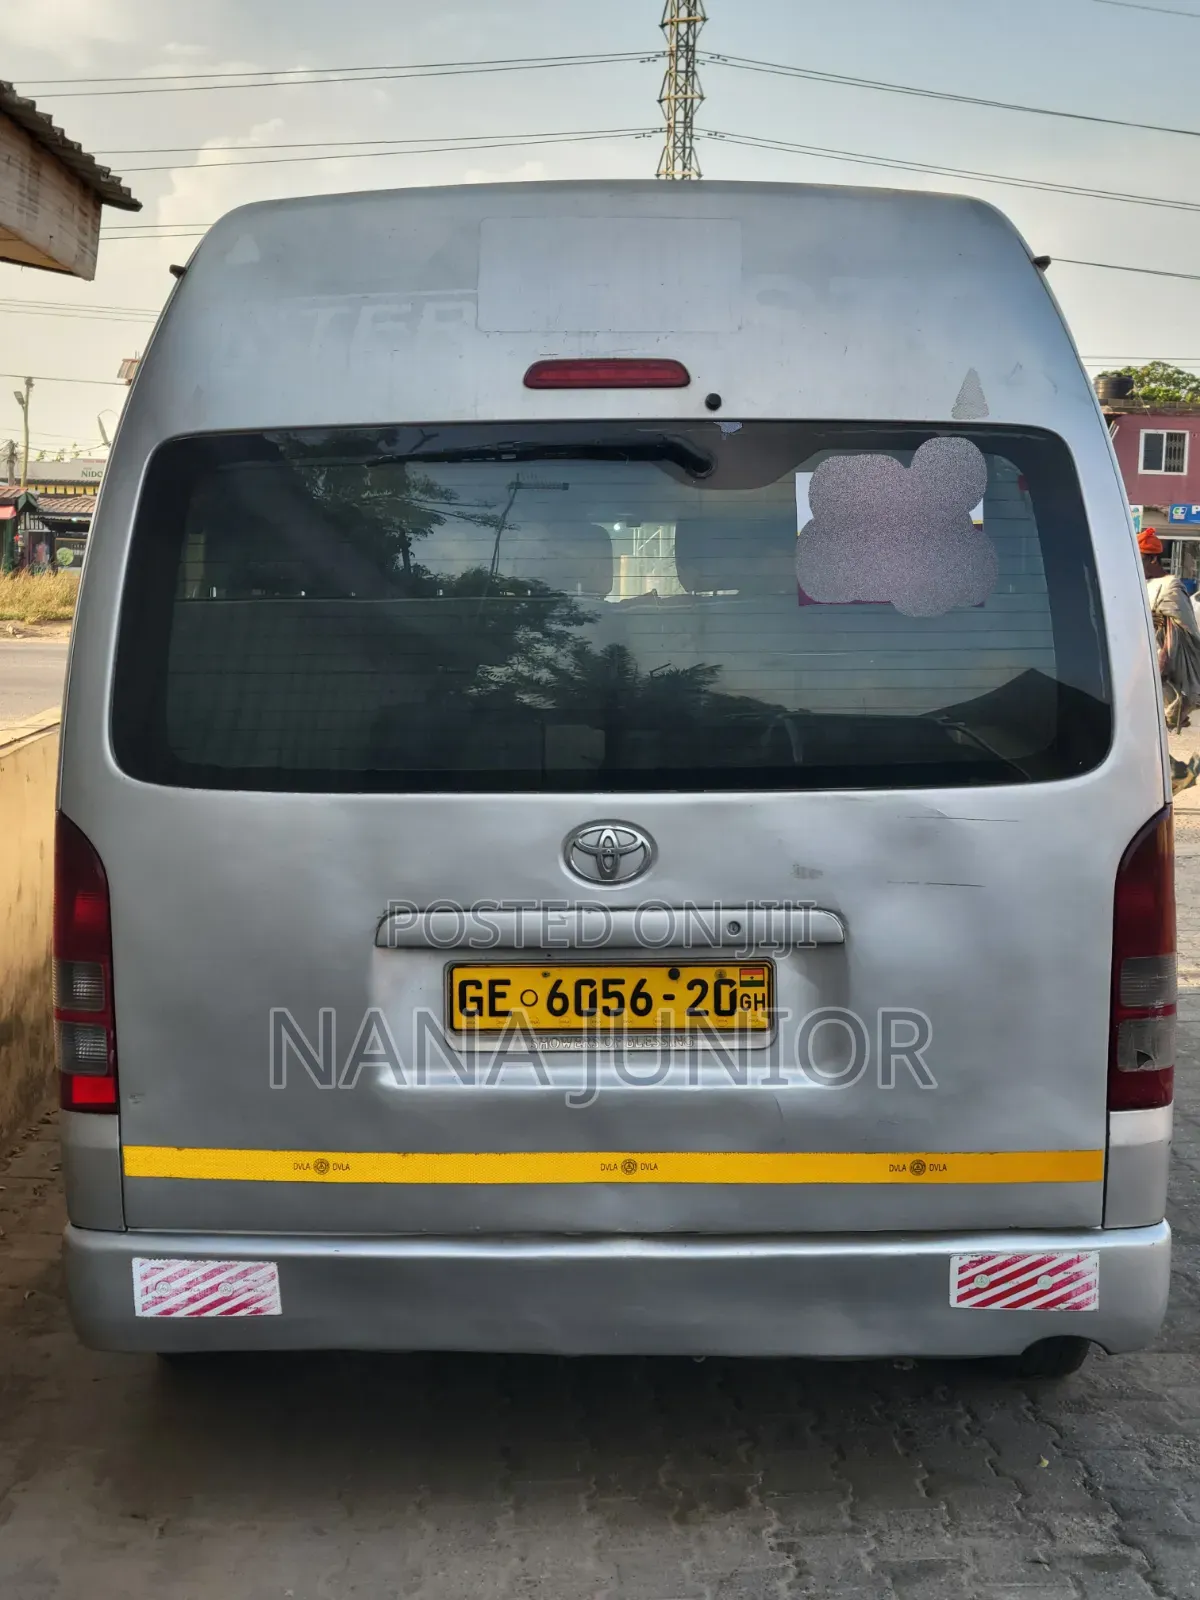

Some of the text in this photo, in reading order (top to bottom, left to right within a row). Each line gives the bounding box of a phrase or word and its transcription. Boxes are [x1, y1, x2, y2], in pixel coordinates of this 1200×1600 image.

[458, 979, 511, 1017] GE
[740, 992, 765, 1011] GH
[293, 1163, 351, 1171] DVLA DVLA
[600, 1163, 659, 1171] DVLA DVLA
[889, 1164, 947, 1172] DVLA DVLA
